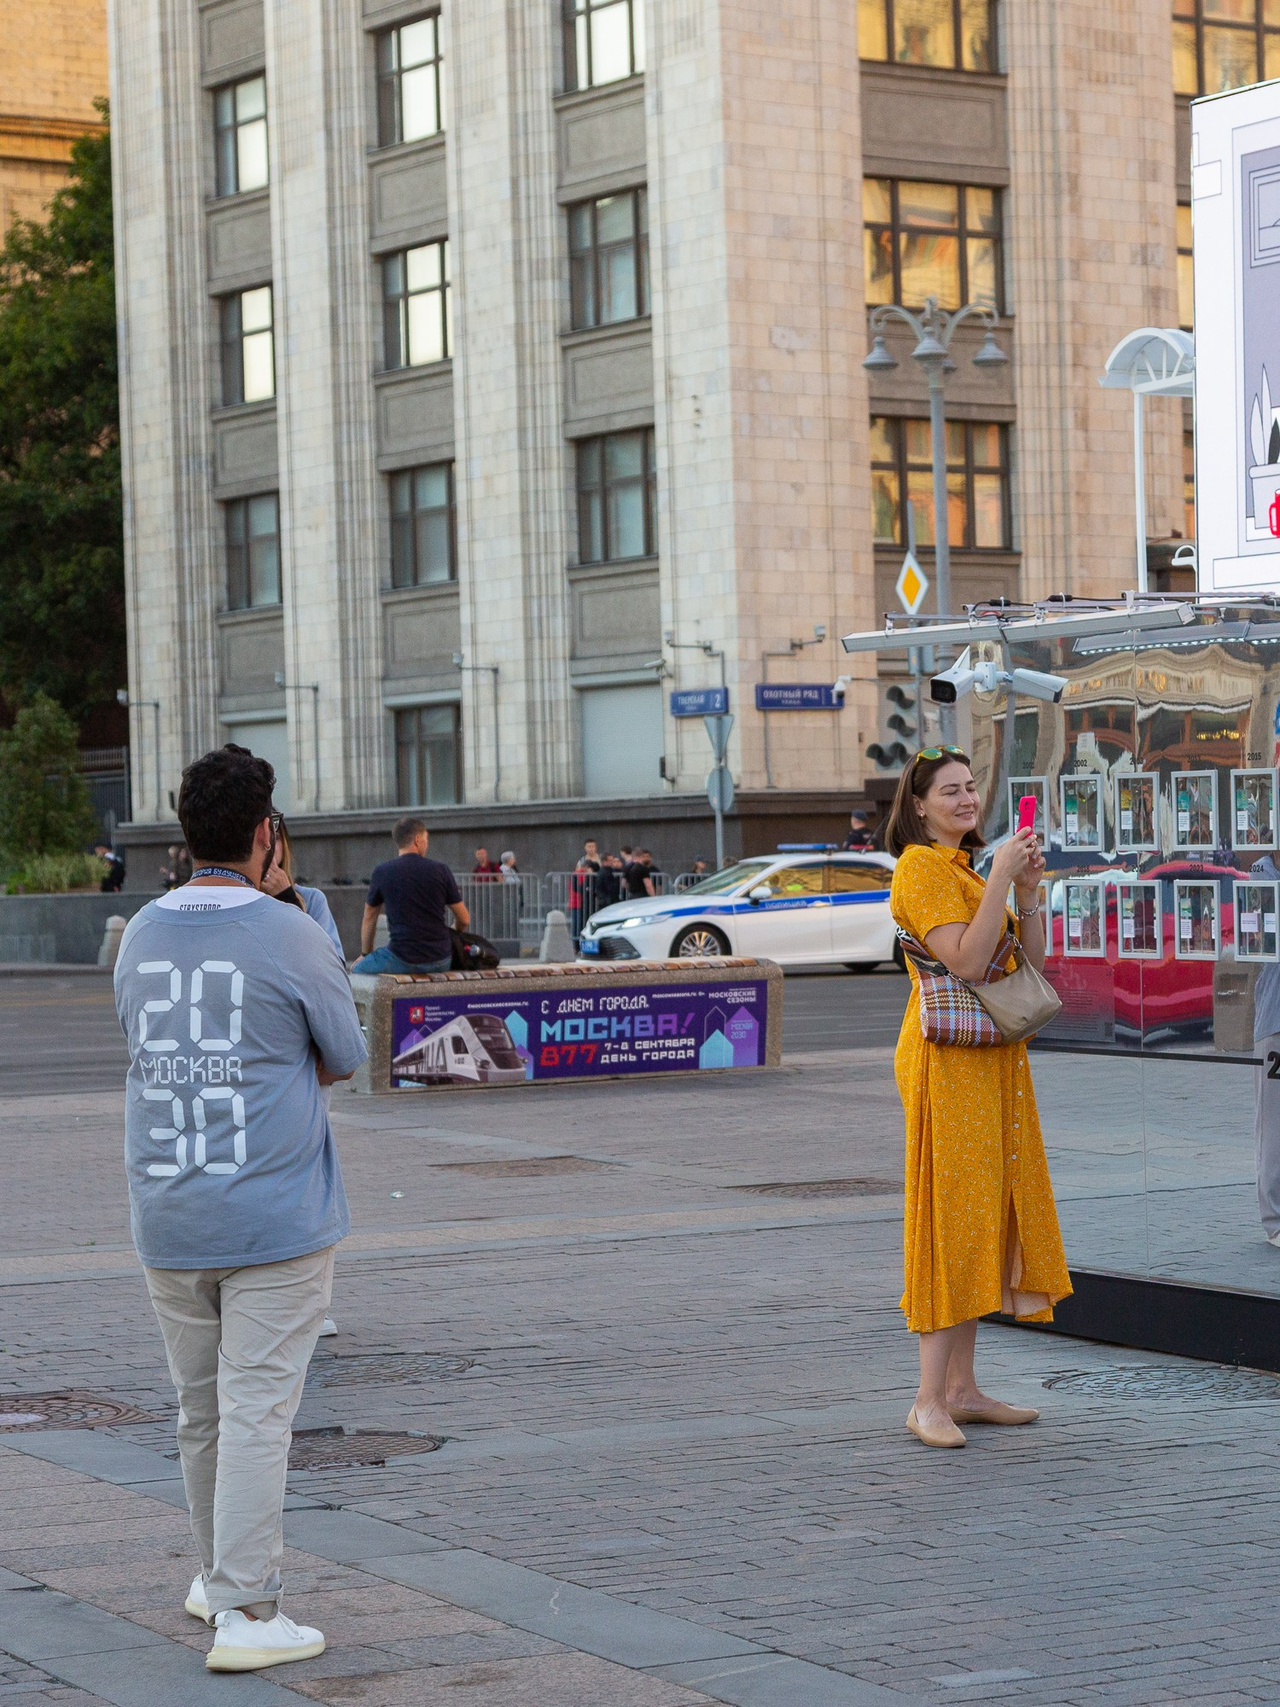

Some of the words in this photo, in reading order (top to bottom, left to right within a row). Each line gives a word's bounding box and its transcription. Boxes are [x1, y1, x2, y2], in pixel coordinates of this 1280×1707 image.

[715, 693, 721, 709] 2
[763, 689, 801, 699] ОХОТНЫЙ
[803, 690, 819, 699] РЯД
[1074, 759, 1088, 767] 2002
[1247, 752, 1262, 761] 2015
[1249, 864, 1264, 873] 2024
[708, 989, 756, 999] МОСКОВСКИЕ
[136, 960, 245, 1052] 20
[541, 1000, 550, 1014] С
[540, 1012, 696, 1043] МОСКВА!
[604, 1041, 629, 1052] 7-8
[635, 1038, 695, 1050] СЕНТЯБРЯ
[540, 1043, 599, 1066] 877
[600, 1053, 637, 1064] ДЕНЬ
[642, 1050, 695, 1060] ГОРОДА
[138, 1055, 243, 1085] МОСКВА
[142, 1086, 248, 1177] 30
